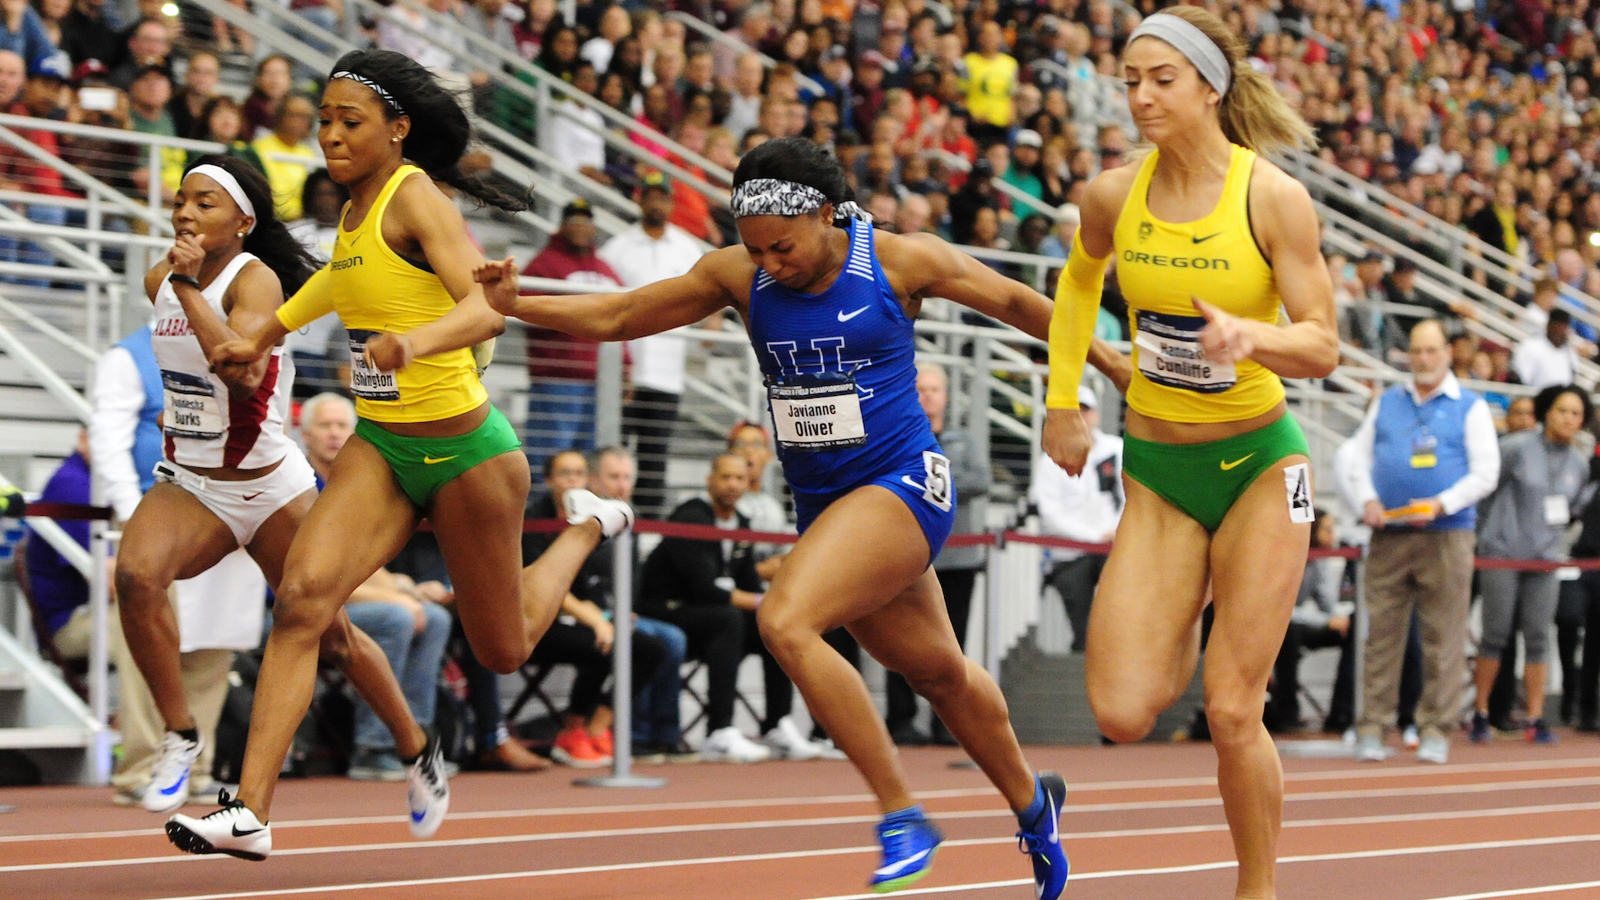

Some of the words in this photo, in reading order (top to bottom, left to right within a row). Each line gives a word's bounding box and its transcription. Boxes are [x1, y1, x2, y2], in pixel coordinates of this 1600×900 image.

[1123, 249, 1229, 270] OREGON
[152, 318, 196, 336] ALABAM
[1156, 357, 1212, 379] Cunliffe
[352, 370, 393, 389] shington
[795, 388, 809, 396] FIELD
[809, 383, 854, 394] CHAMPIONSHIPS
[175, 412, 201, 427] Burks
[788, 404, 837, 418] Javianne
[795, 421, 834, 437] Oliver
[931, 456, 946, 503] 5
[1293, 468, 1309, 518] 4
